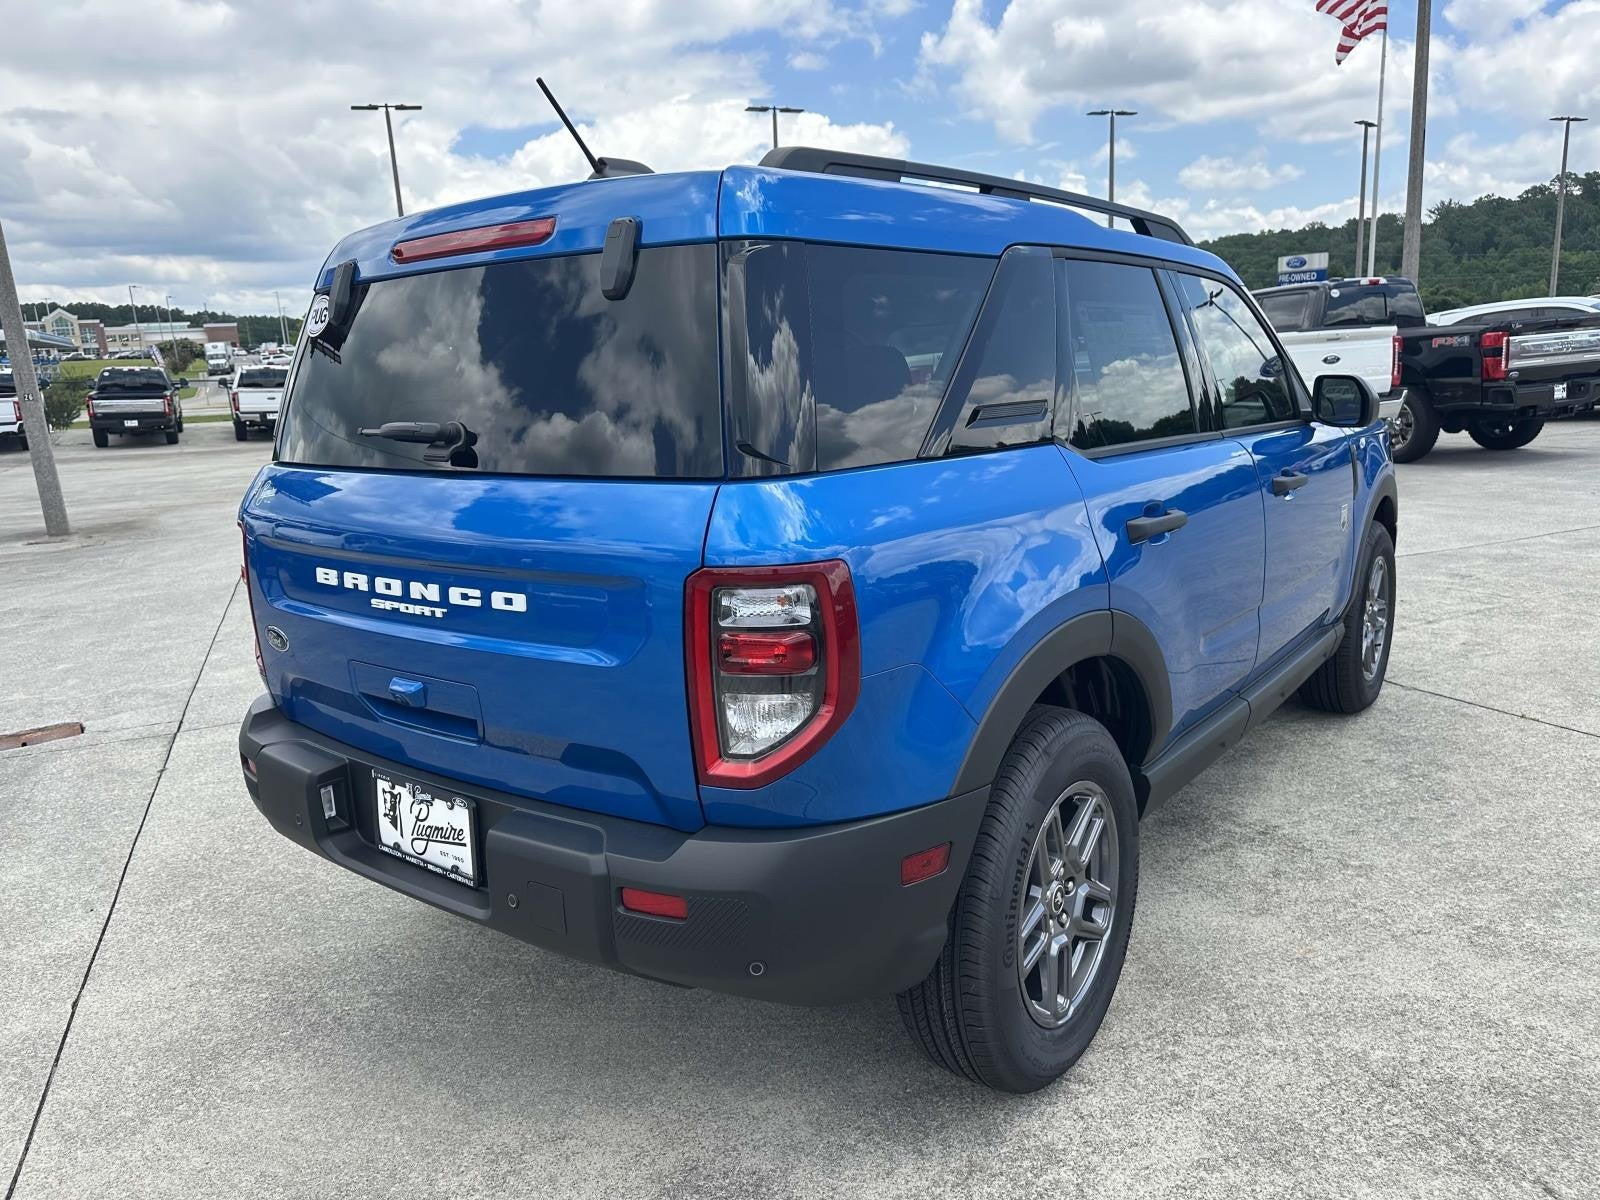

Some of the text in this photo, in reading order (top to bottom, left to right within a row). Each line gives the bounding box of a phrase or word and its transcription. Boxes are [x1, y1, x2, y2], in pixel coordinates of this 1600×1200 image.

[1278, 271, 1317, 282] PRE-OWNED
[311, 306, 329, 325] PUG
[1432, 335, 1470, 347] FX4
[315, 567, 527, 613] BRONCO
[370, 598, 447, 618] SPORT
[409, 800, 467, 855] Pugmire
